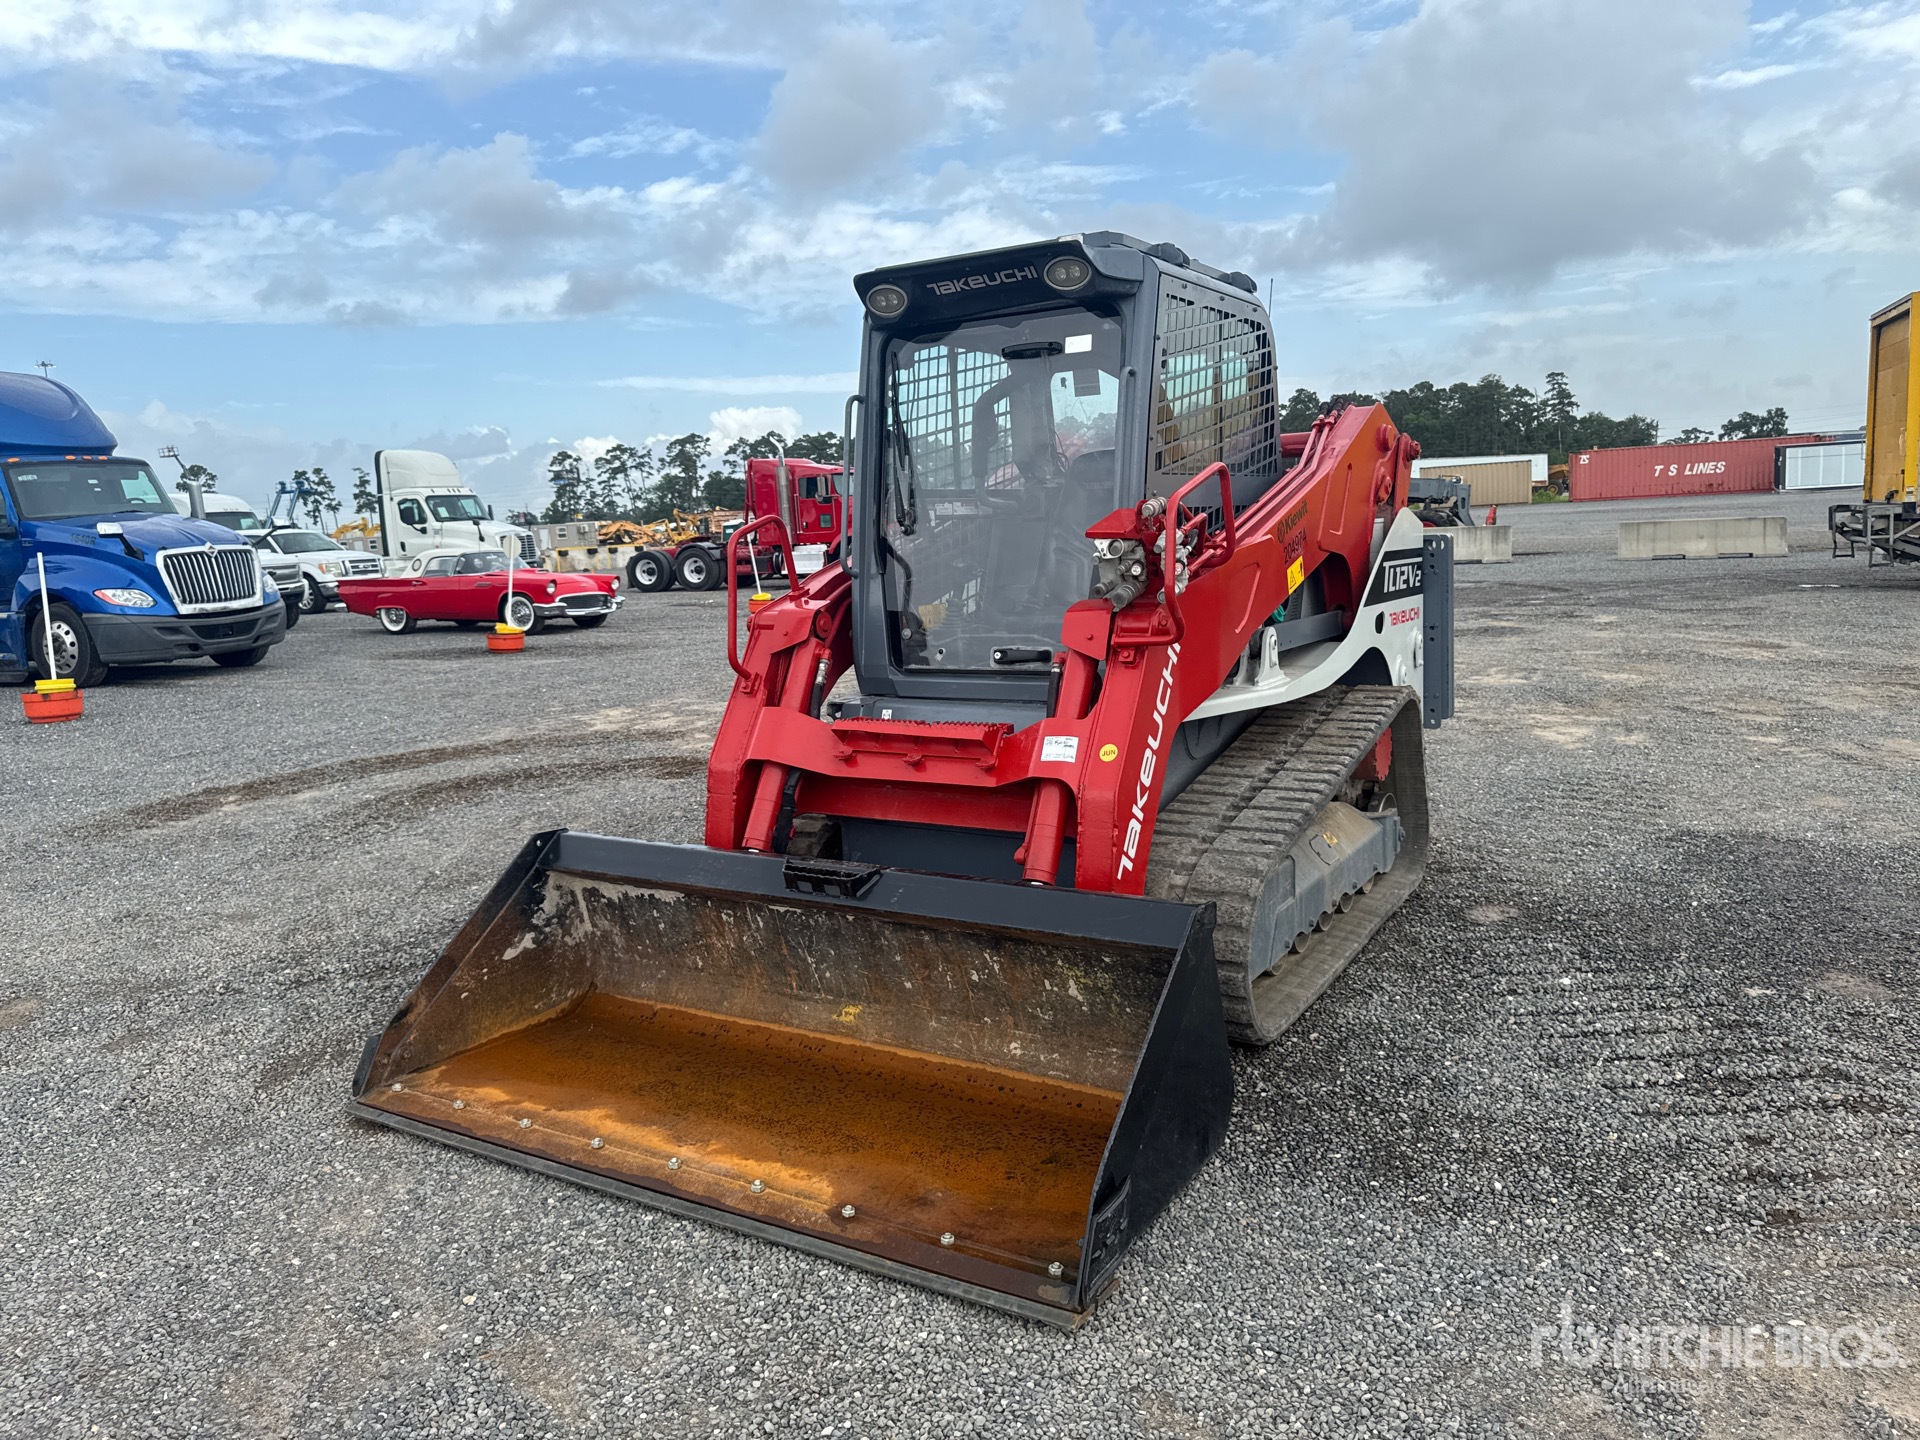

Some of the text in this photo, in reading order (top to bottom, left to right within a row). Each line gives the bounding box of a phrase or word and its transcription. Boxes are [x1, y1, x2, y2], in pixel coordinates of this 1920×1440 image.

[926, 265, 1039, 296] TAKEUCHI
[1654, 460, 1727, 477] T S LINES
[1284, 500, 1309, 535] Kiewit
[1388, 606, 1421, 627] TAKEUCHI
[1101, 749, 1117, 758] JUN
